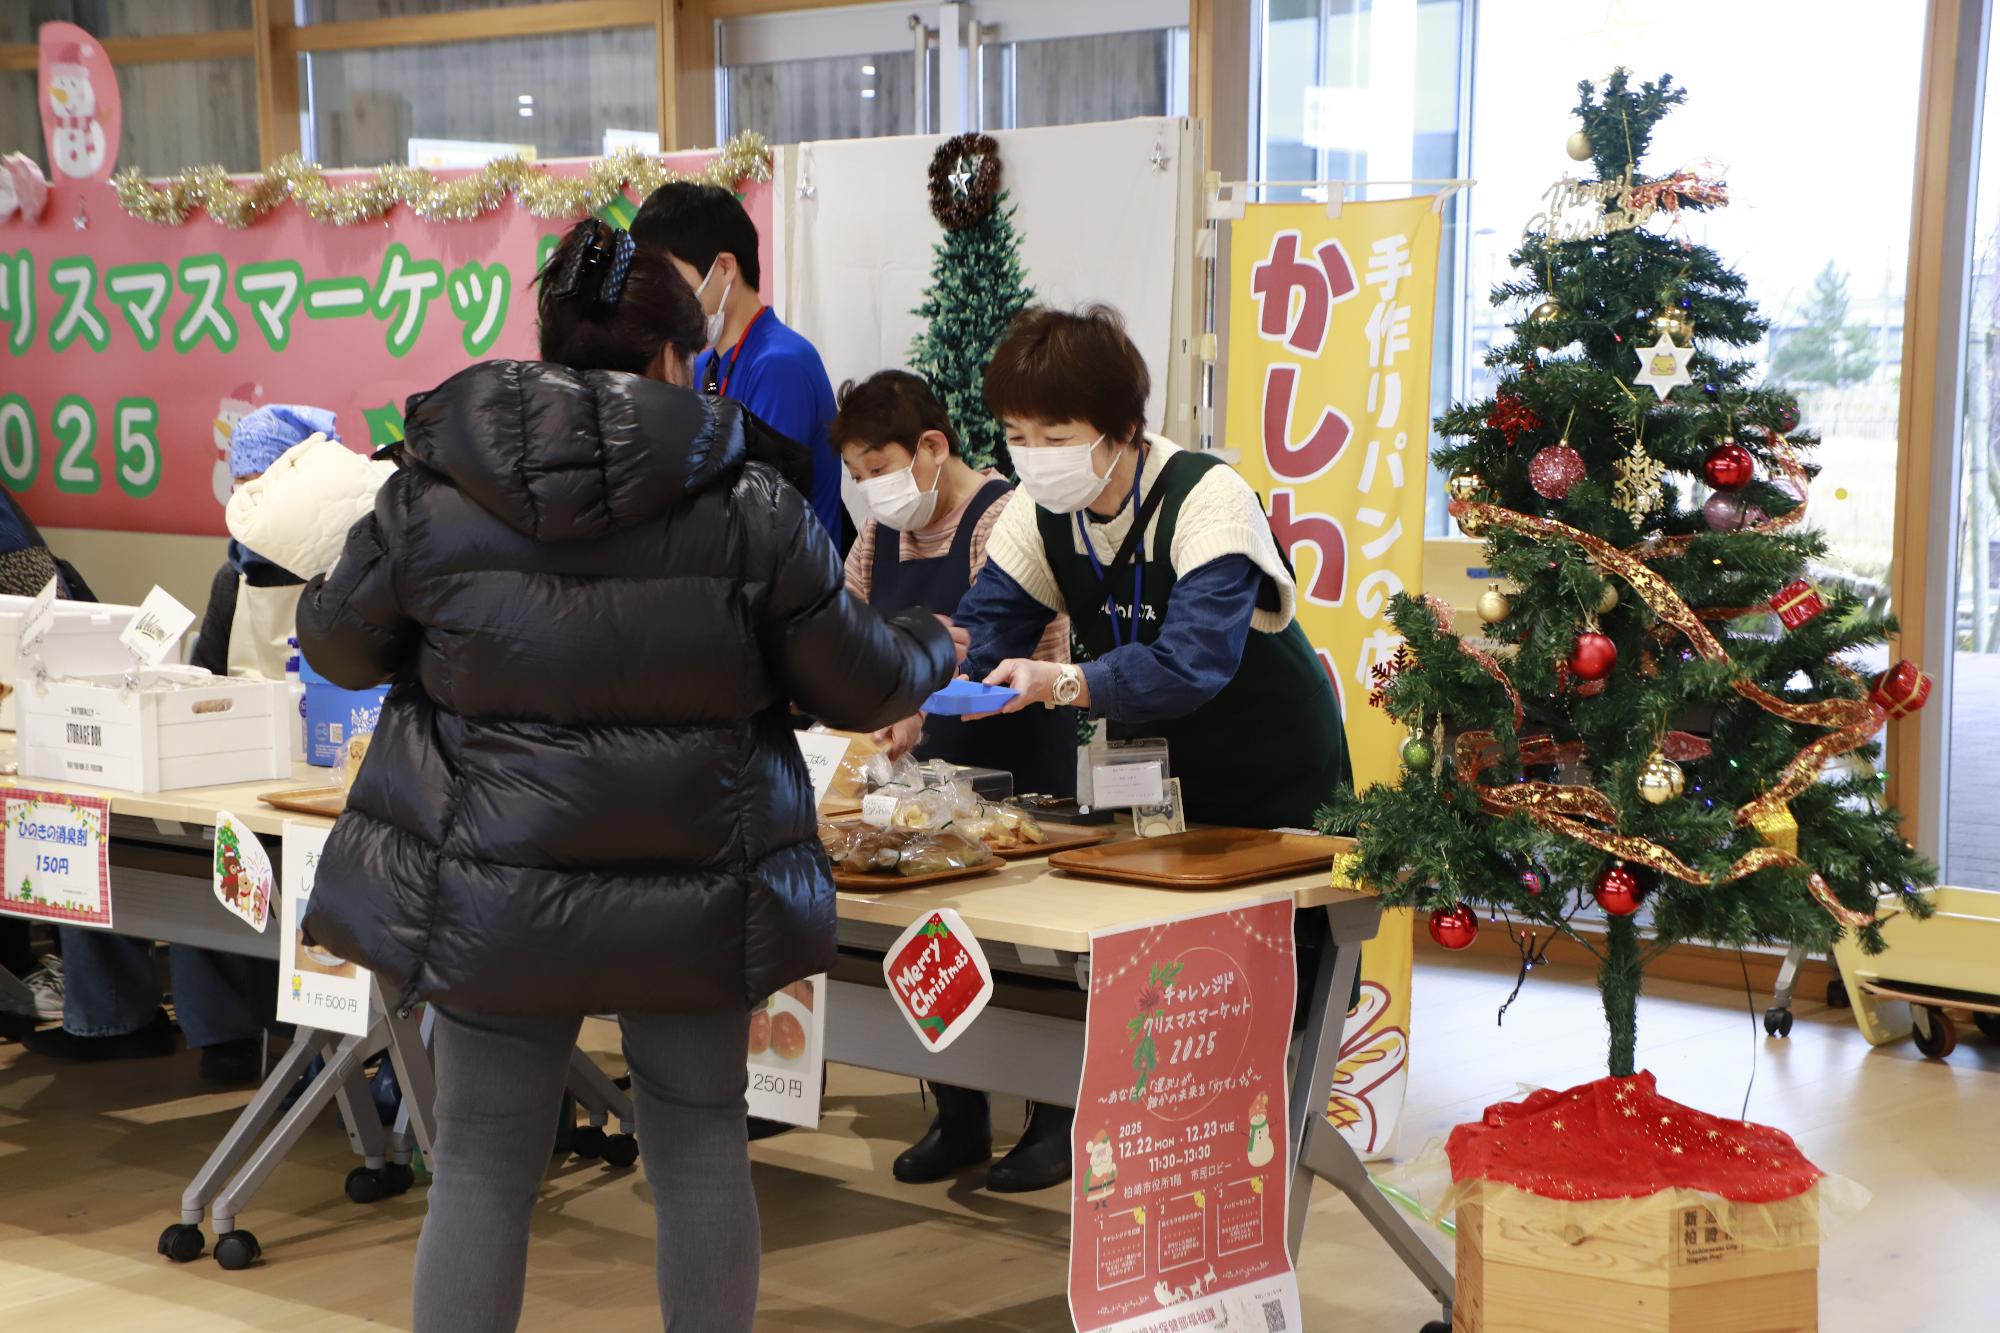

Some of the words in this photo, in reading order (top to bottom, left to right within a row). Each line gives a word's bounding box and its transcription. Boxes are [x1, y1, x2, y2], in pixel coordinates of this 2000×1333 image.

[1541, 162, 1635, 216] Merry
[1521, 202, 1655, 248] Christmas
[0, 236, 558, 357] リスマスマーケッ
[66, 723, 90, 746] STORAGE
[91, 725, 102, 747] BOX
[18, 821, 88, 847] ひのきの消臭剤
[36, 855, 69, 875] 150円
[896, 939, 940, 997] Merry
[911, 949, 969, 1018] Christmas
[1164, 971, 1235, 1006] チャレンジド
[1144, 997, 1251, 1036] クリスマスマーケット
[1170, 1031, 1217, 1065] 2025
[1119, 1121, 1142, 1138] 2025
[1119, 1136, 1152, 1159] 12.22
[1154, 1137, 1175, 1151] MON
[1186, 1120, 1217, 1143] 12.23
[1219, 1121, 1235, 1134] TUE
[1190, 1163, 1232, 1181] 市民ロビー
